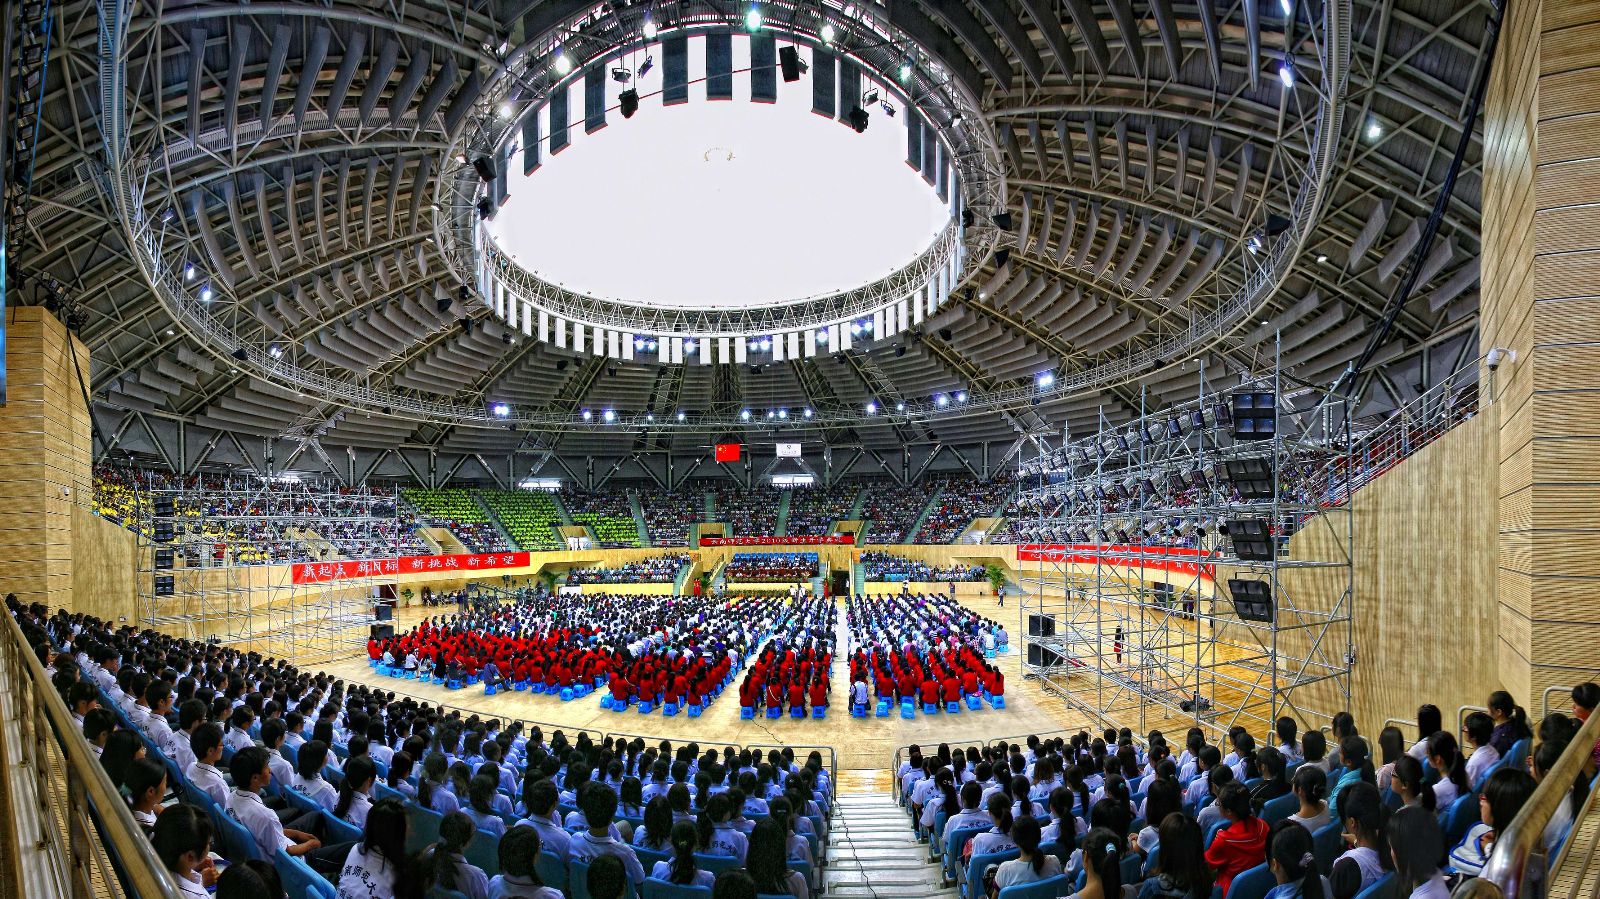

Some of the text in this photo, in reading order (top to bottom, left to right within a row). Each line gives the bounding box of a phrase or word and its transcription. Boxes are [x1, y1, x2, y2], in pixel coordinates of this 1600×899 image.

[303, 555, 516, 578] 新起点 新目标 新挑战 新希望
